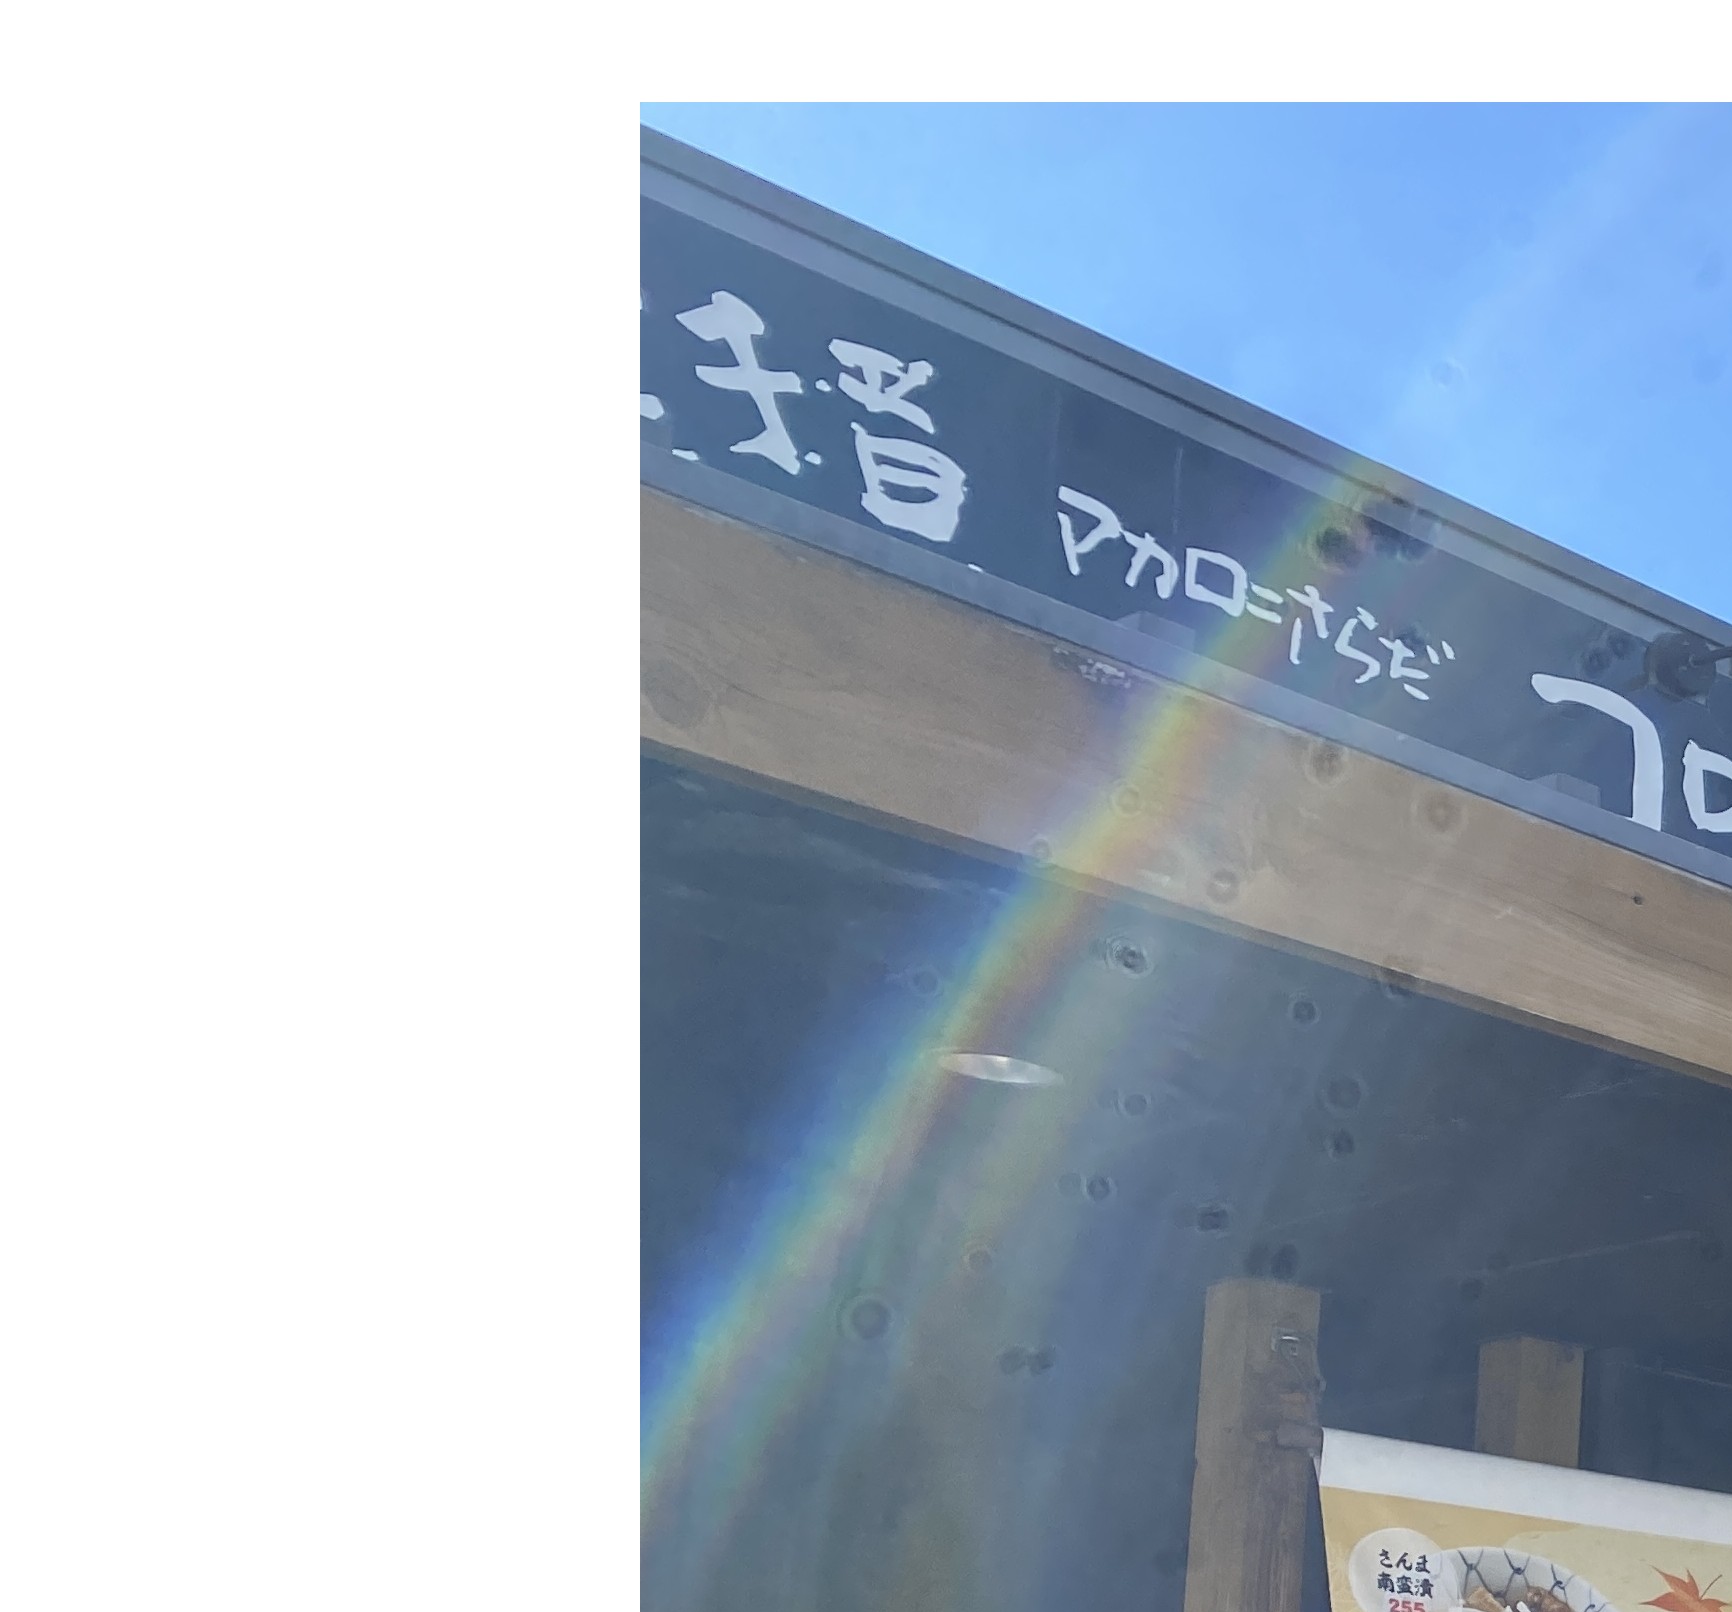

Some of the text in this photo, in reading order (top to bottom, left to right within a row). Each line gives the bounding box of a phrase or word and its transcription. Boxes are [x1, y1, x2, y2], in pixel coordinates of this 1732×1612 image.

[1057, 485, 1455, 701] マカロニさらだ
[1378, 1548, 1430, 1574] さんま
